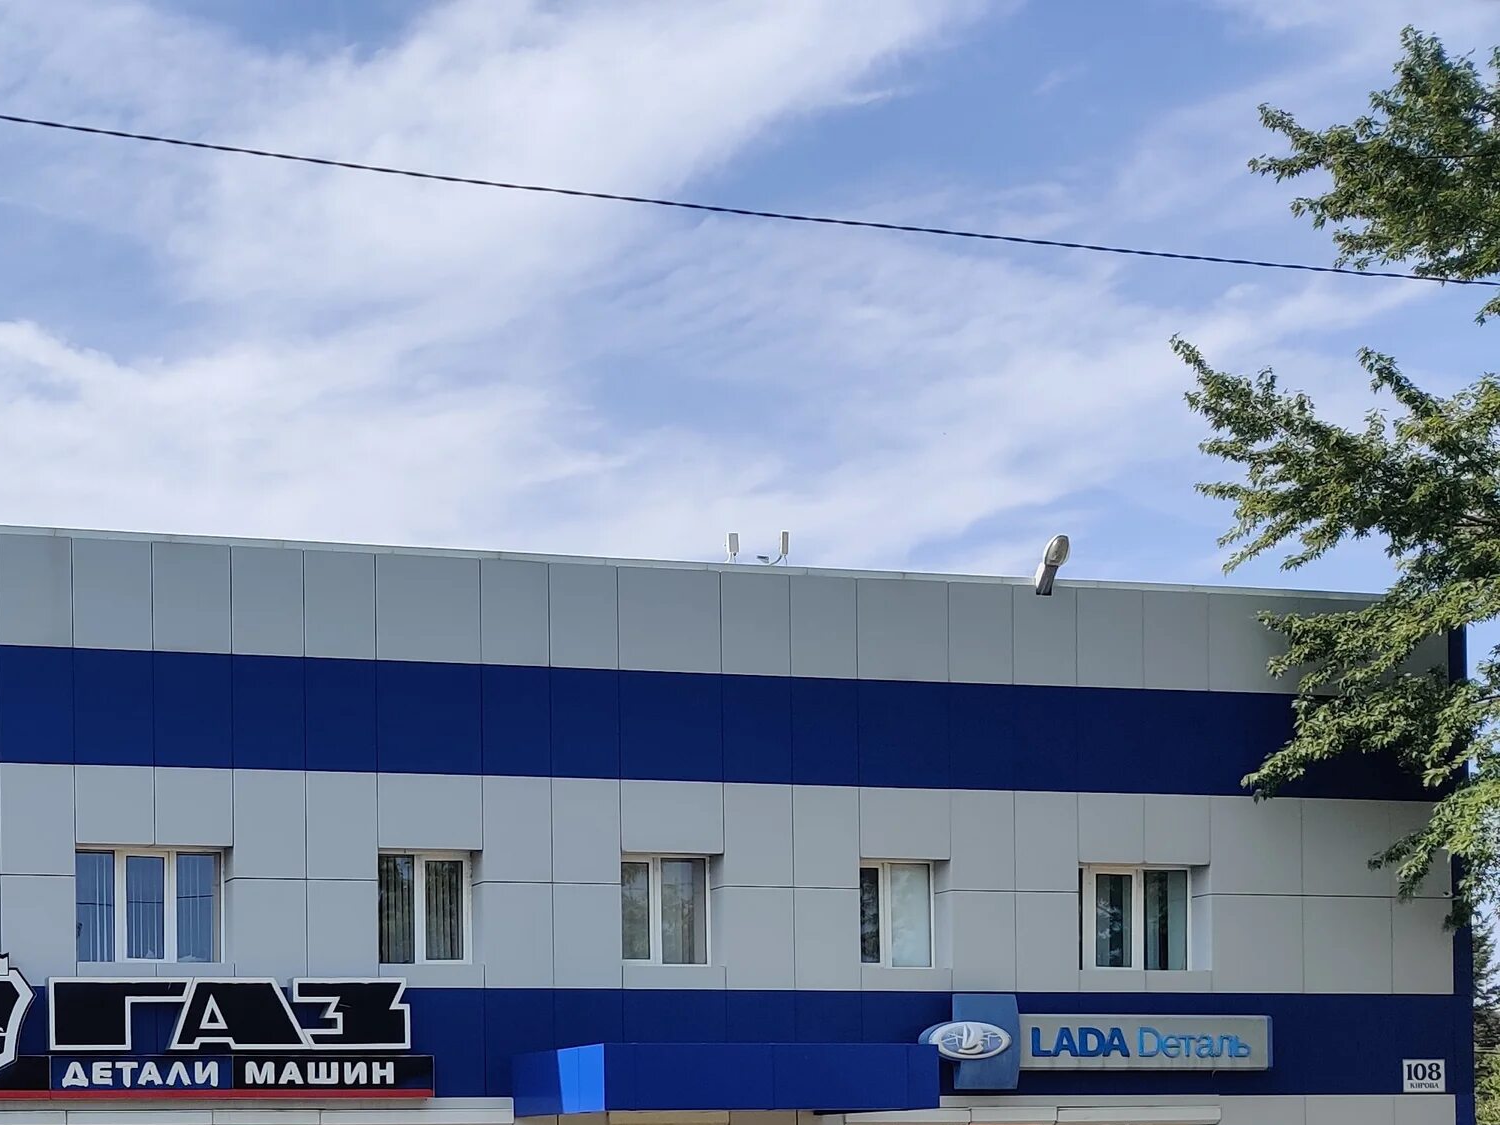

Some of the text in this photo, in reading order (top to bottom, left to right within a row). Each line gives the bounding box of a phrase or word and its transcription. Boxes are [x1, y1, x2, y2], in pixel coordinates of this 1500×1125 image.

[47, 976, 412, 1051] ГАЗ
[1031, 1026, 1130, 1058] LADA
[61, 1060, 396, 1087] ДЕТАЛИ МАШИН
[1406, 1062, 1442, 1081] 108
